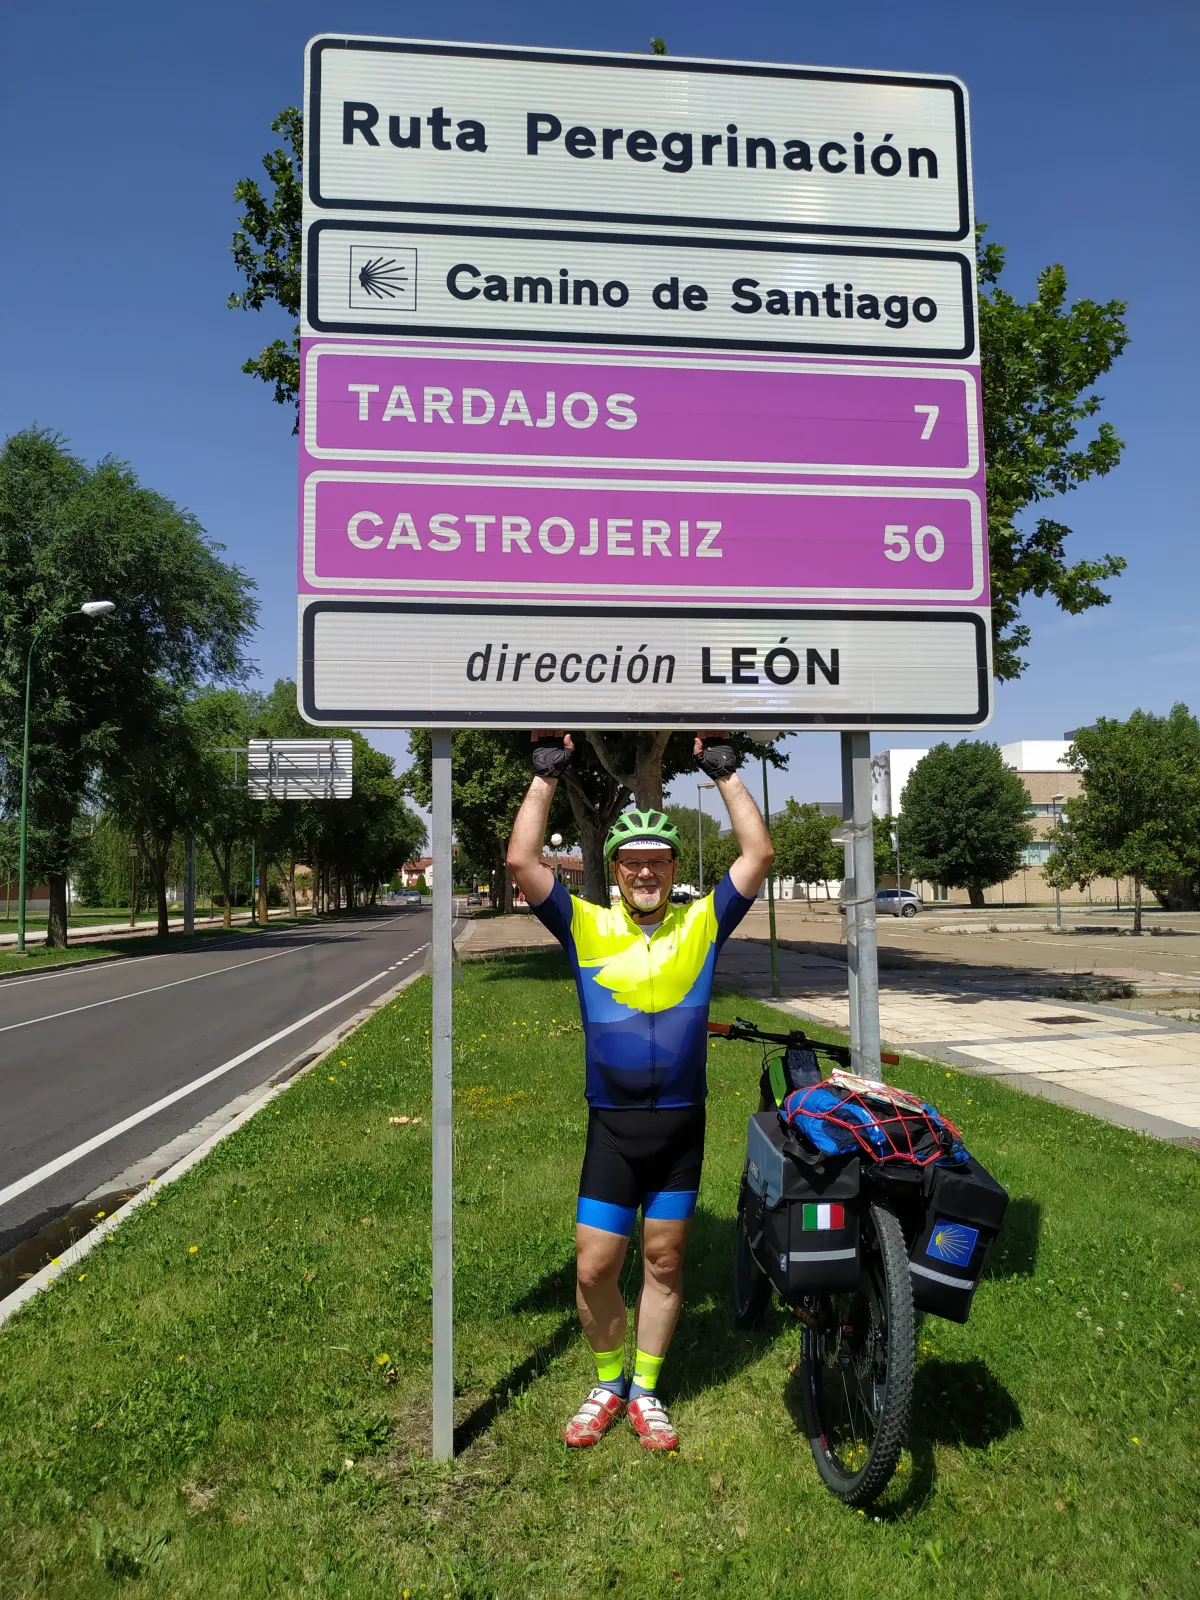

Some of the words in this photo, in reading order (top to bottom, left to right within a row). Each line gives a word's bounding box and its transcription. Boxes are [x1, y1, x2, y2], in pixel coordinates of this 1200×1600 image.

[343, 101, 488, 153] Ruta
[527, 113, 938, 178] Peregrinación
[447, 264, 629, 307] Camino
[652, 277, 708, 311] de
[731, 278, 937, 328] Santiago
[348, 384, 637, 430] TARDAJOS
[915, 405, 939, 439] 7
[348, 511, 722, 557] CASTROJERIZ
[884, 525, 944, 562] 50
[467, 644, 675, 683] dirección
[702, 637, 839, 685] LEÓN
